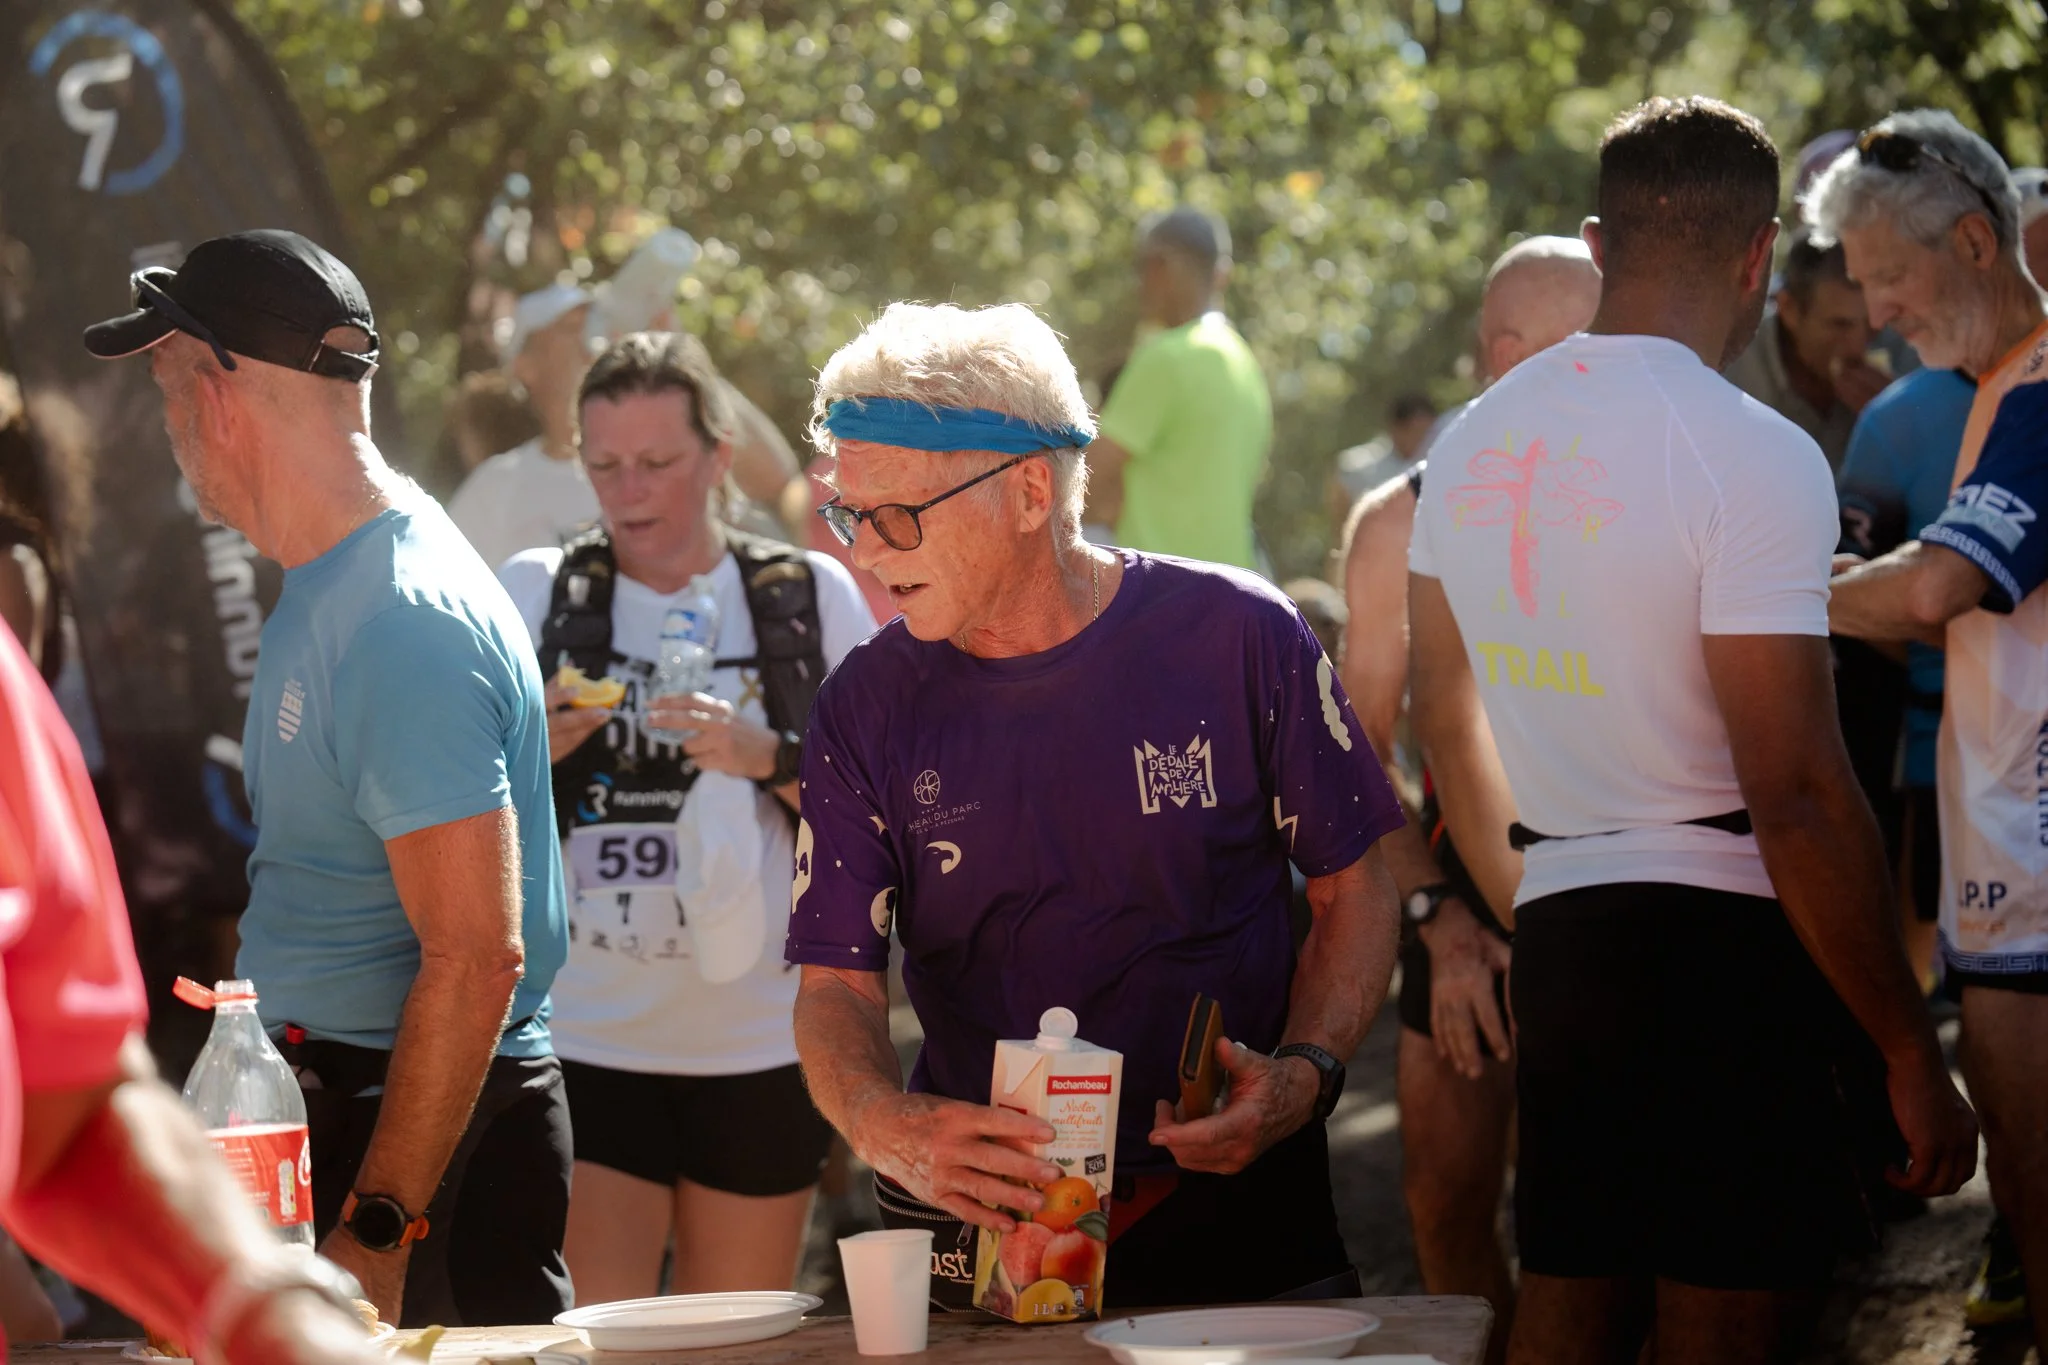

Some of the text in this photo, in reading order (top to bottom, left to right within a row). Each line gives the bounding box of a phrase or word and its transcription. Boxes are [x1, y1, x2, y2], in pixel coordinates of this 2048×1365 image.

[1476, 641, 1605, 696] TRAIL
[1168, 743, 1177, 755] LE
[1149, 753, 1199, 774] DÉDALE
[1169, 769, 1183, 780] DE
[934, 810, 948, 821] DU
[952, 801, 981, 815] PARC
[597, 834, 679, 881] 59
[1052, 1079, 1107, 1090] Rochambeau
[1059, 1099, 1096, 1113] Nectar
[1051, 1114, 1103, 1128] multifruits
